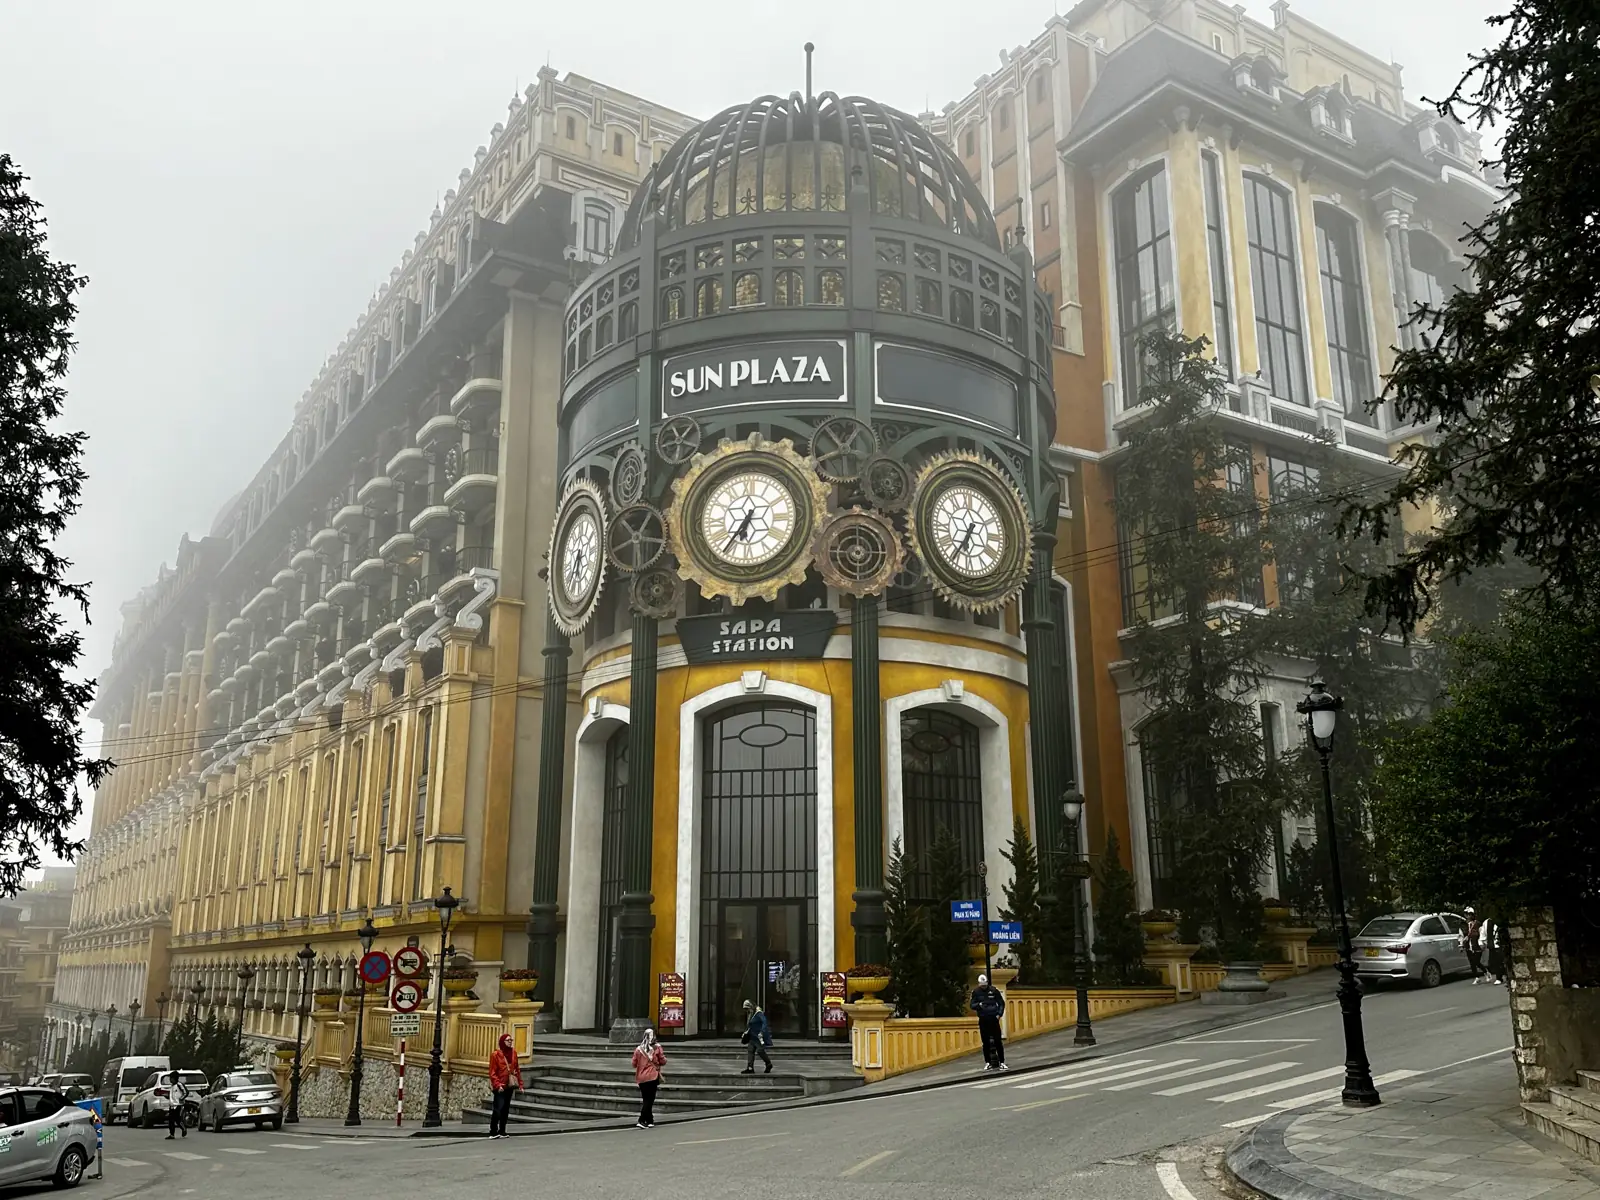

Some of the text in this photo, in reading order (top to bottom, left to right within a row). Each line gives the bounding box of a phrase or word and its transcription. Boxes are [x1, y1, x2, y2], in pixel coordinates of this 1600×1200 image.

[670, 355, 831, 397] SUN PLAZA
[720, 619, 781, 635] SAPA
[712, 636, 794, 653] STATION
